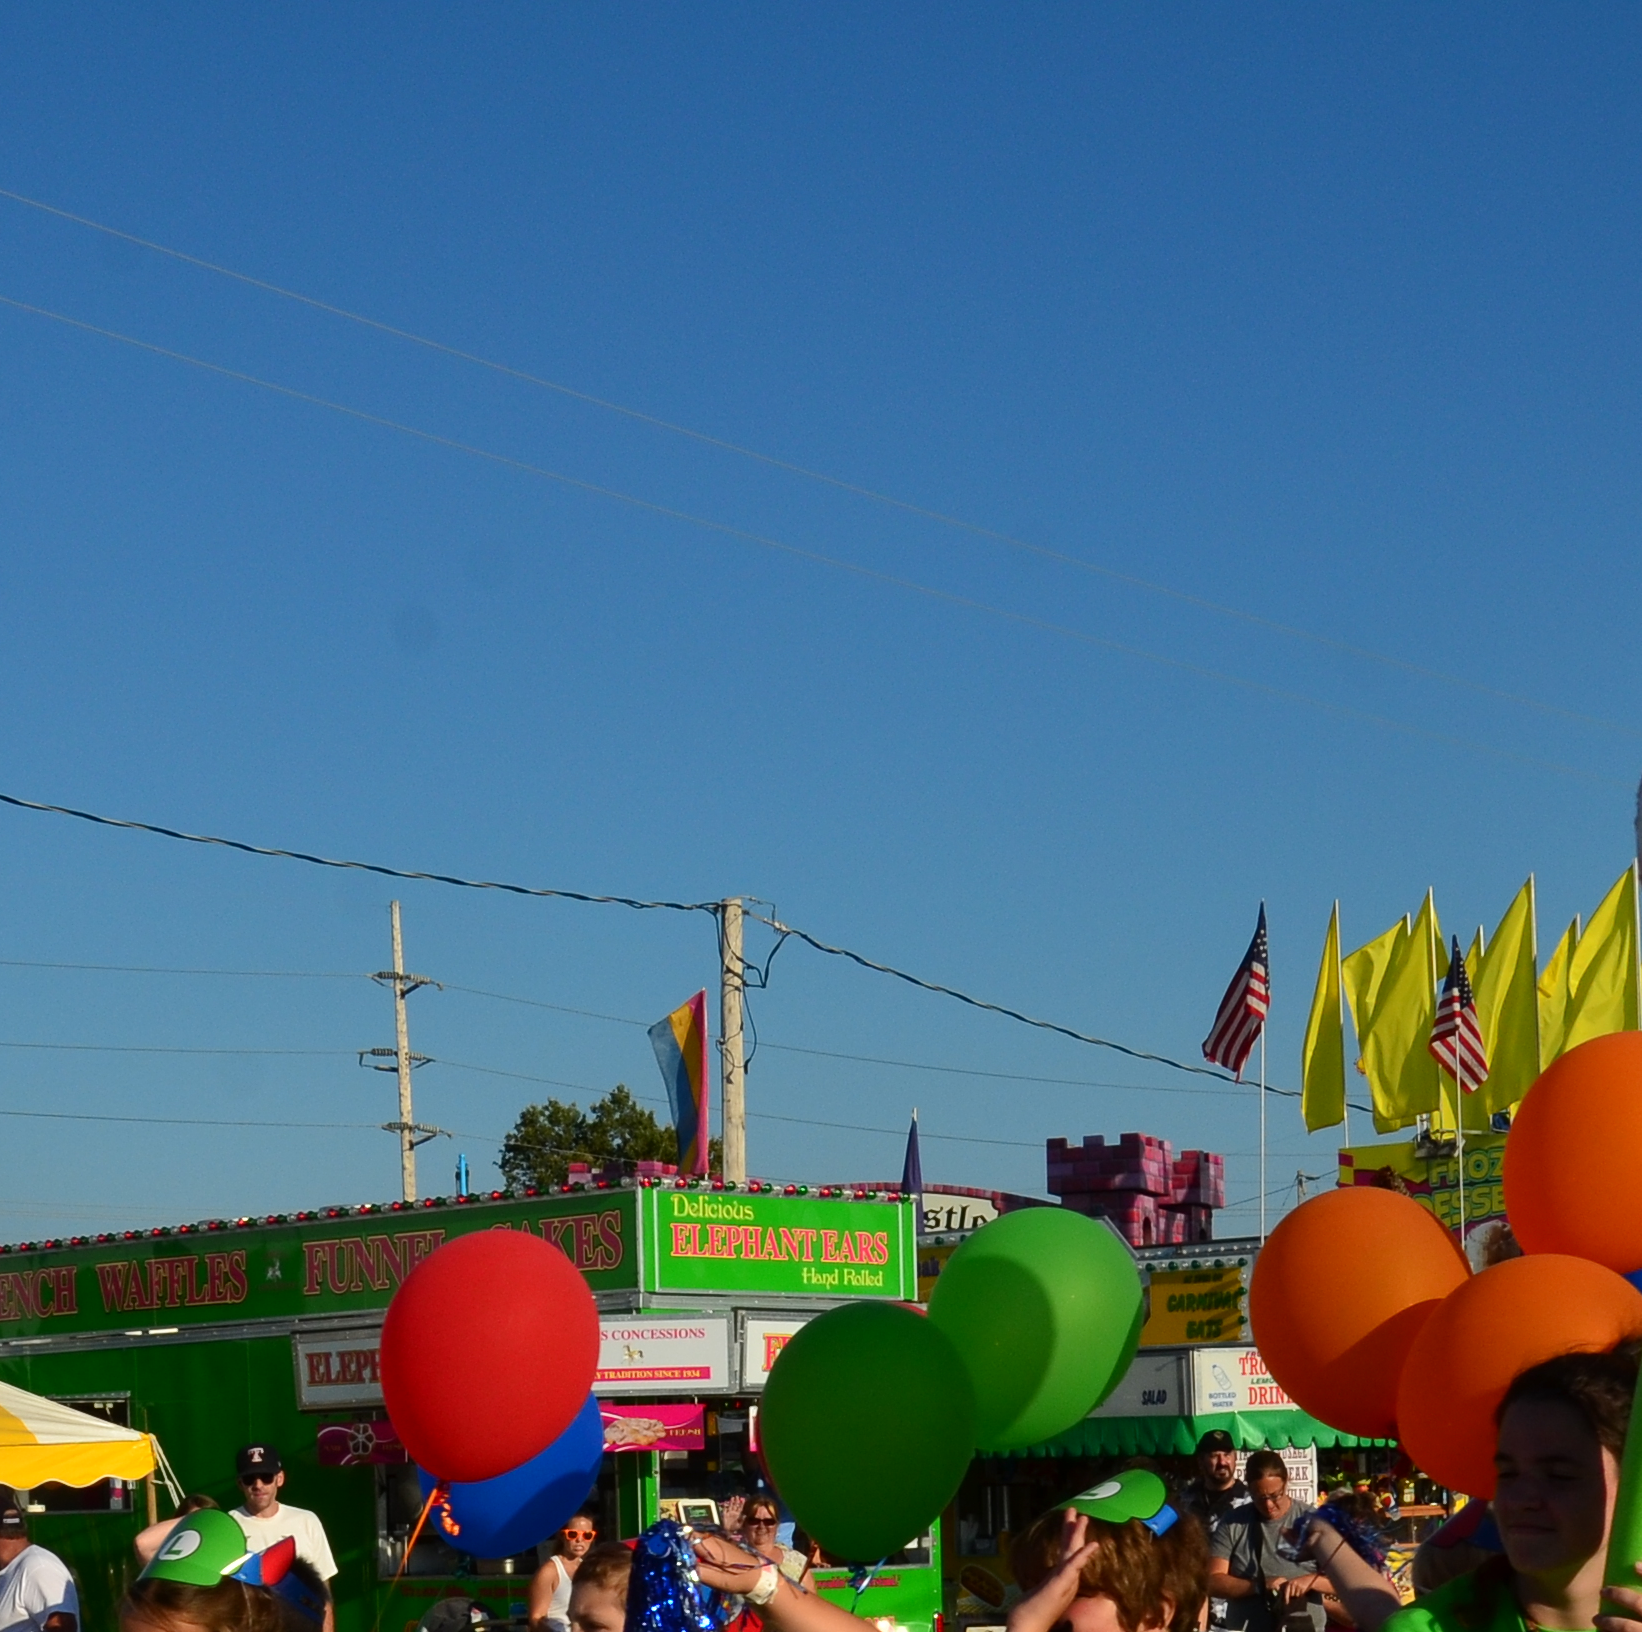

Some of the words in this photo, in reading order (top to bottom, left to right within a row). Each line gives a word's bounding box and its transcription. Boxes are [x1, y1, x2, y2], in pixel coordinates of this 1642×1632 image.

[670, 1194, 755, 1221] Delicious
[670, 1222, 817, 1263] ELEPHANT
[820, 1229, 889, 1265] EARS
[95, 1249, 248, 1313] WAFFLES
[801, 1267, 839, 1289] Hand
[843, 1268, 884, 1287] Rolled
[612, 1328, 706, 1341] CONCESSIONS
[604, 1369, 653, 1380] TRADITION
[654, 1369, 681, 1379] SINCE
[1141, 1389, 1168, 1405] SALAD
[1208, 1391, 1237, 1400] BOTTLED
[1211, 1400, 1234, 1408] WATER
[163, 1535, 184, 1556] L
